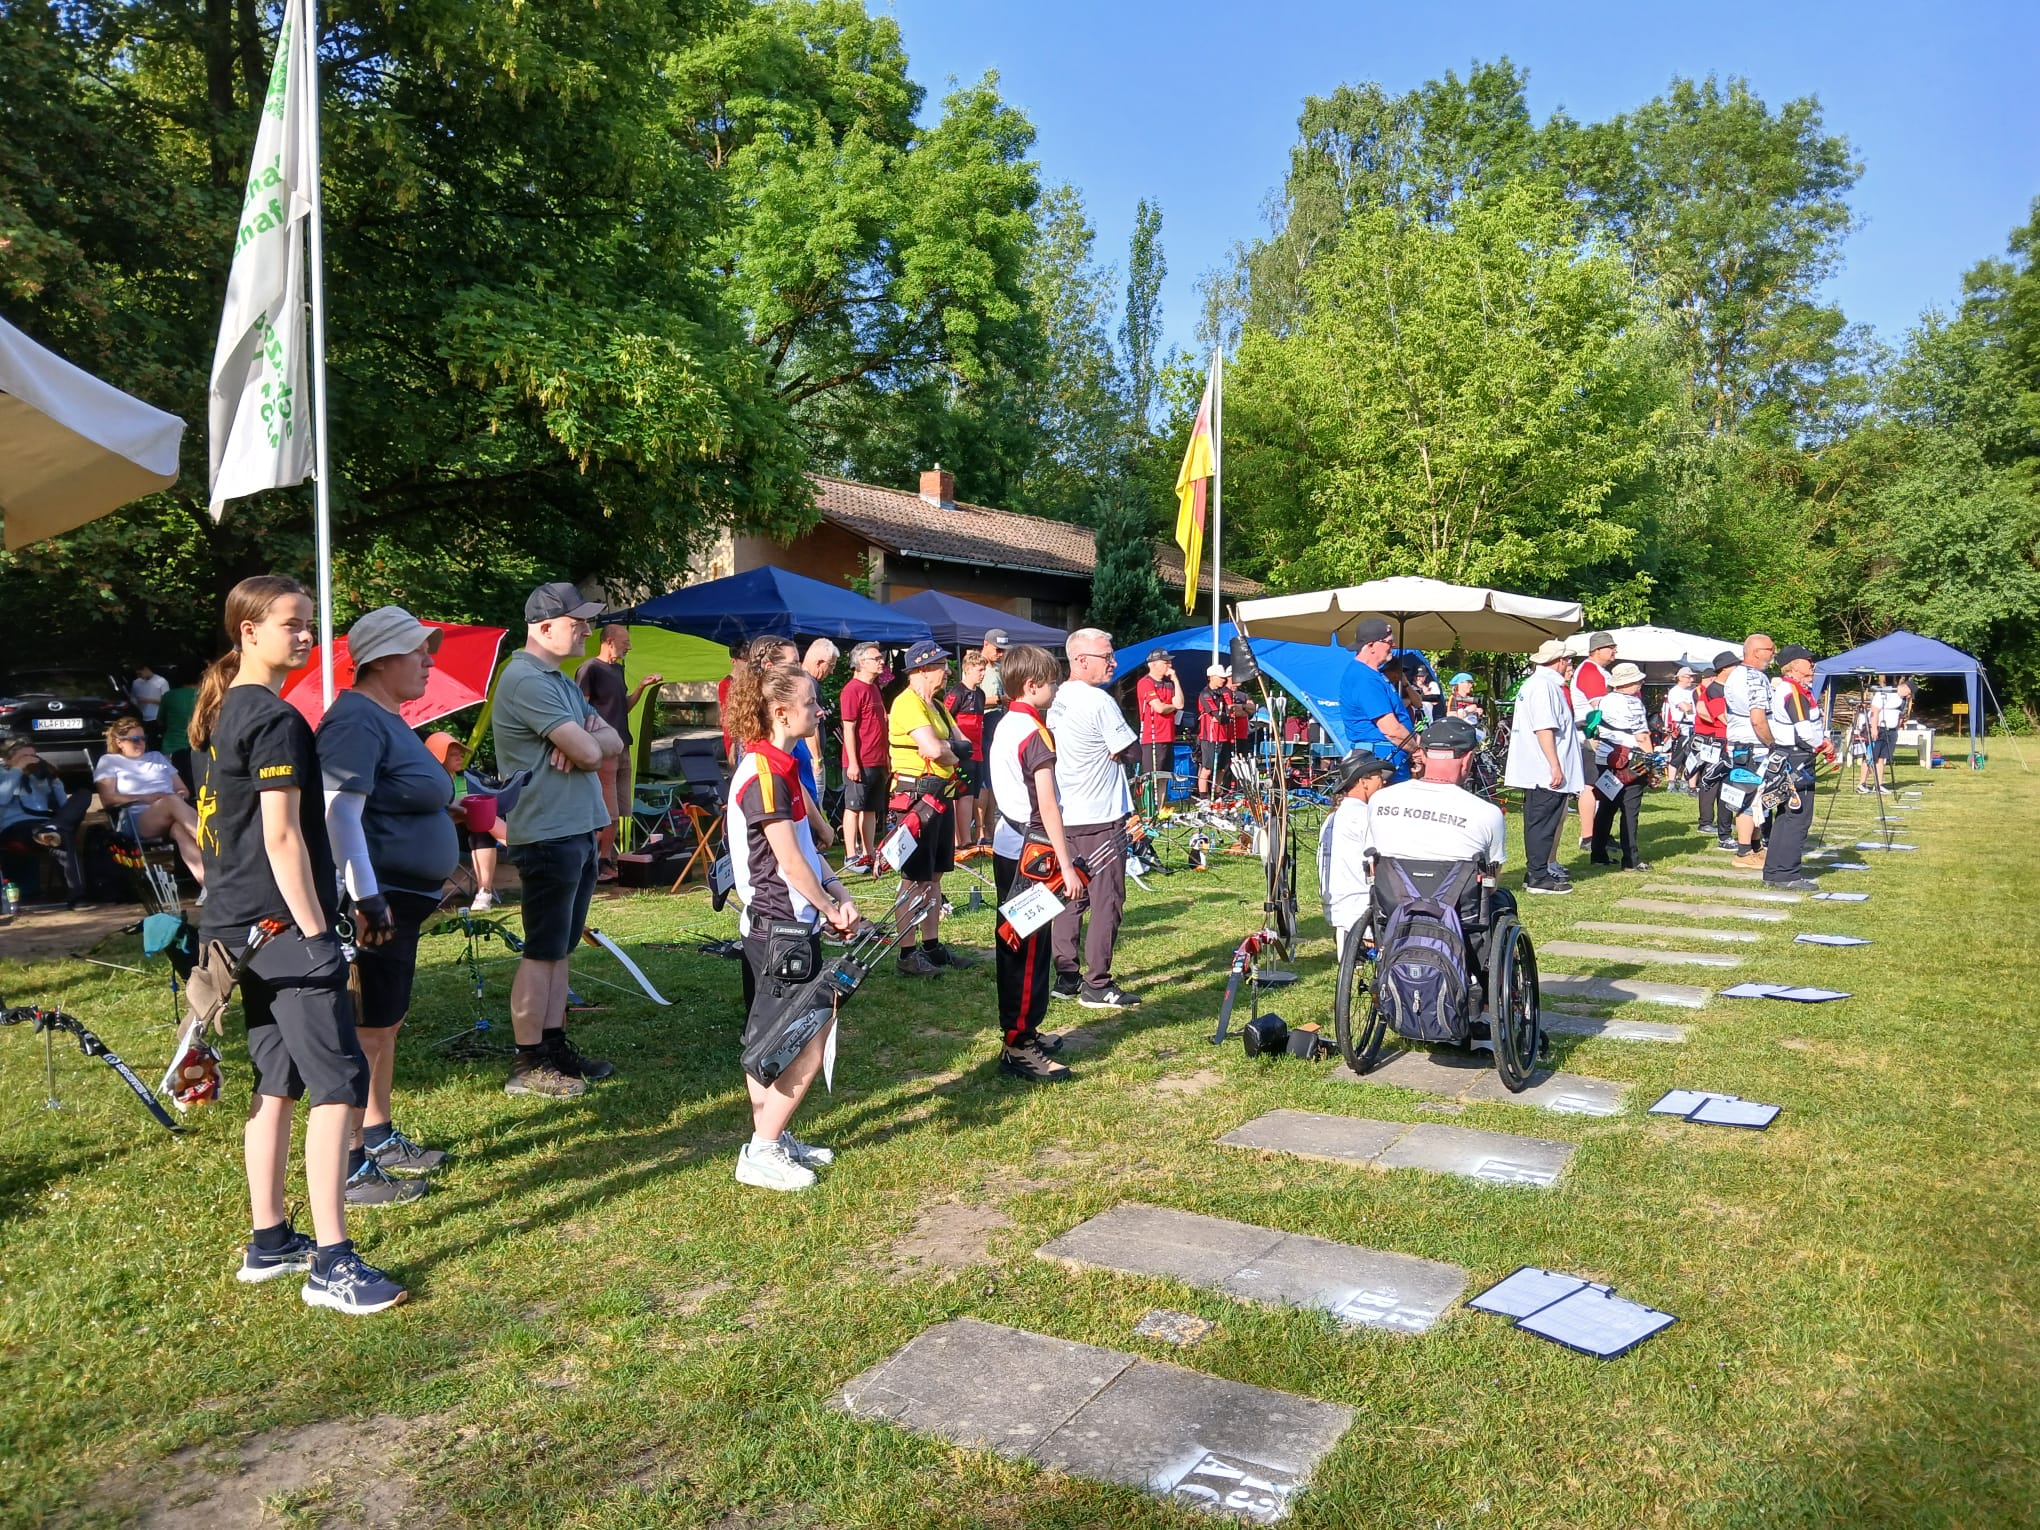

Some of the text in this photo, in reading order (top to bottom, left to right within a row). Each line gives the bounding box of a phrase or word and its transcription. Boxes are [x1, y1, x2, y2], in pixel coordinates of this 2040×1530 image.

[1376, 805, 1468, 829] RSG KOBLENZ
[1024, 908, 1037, 921] 15
